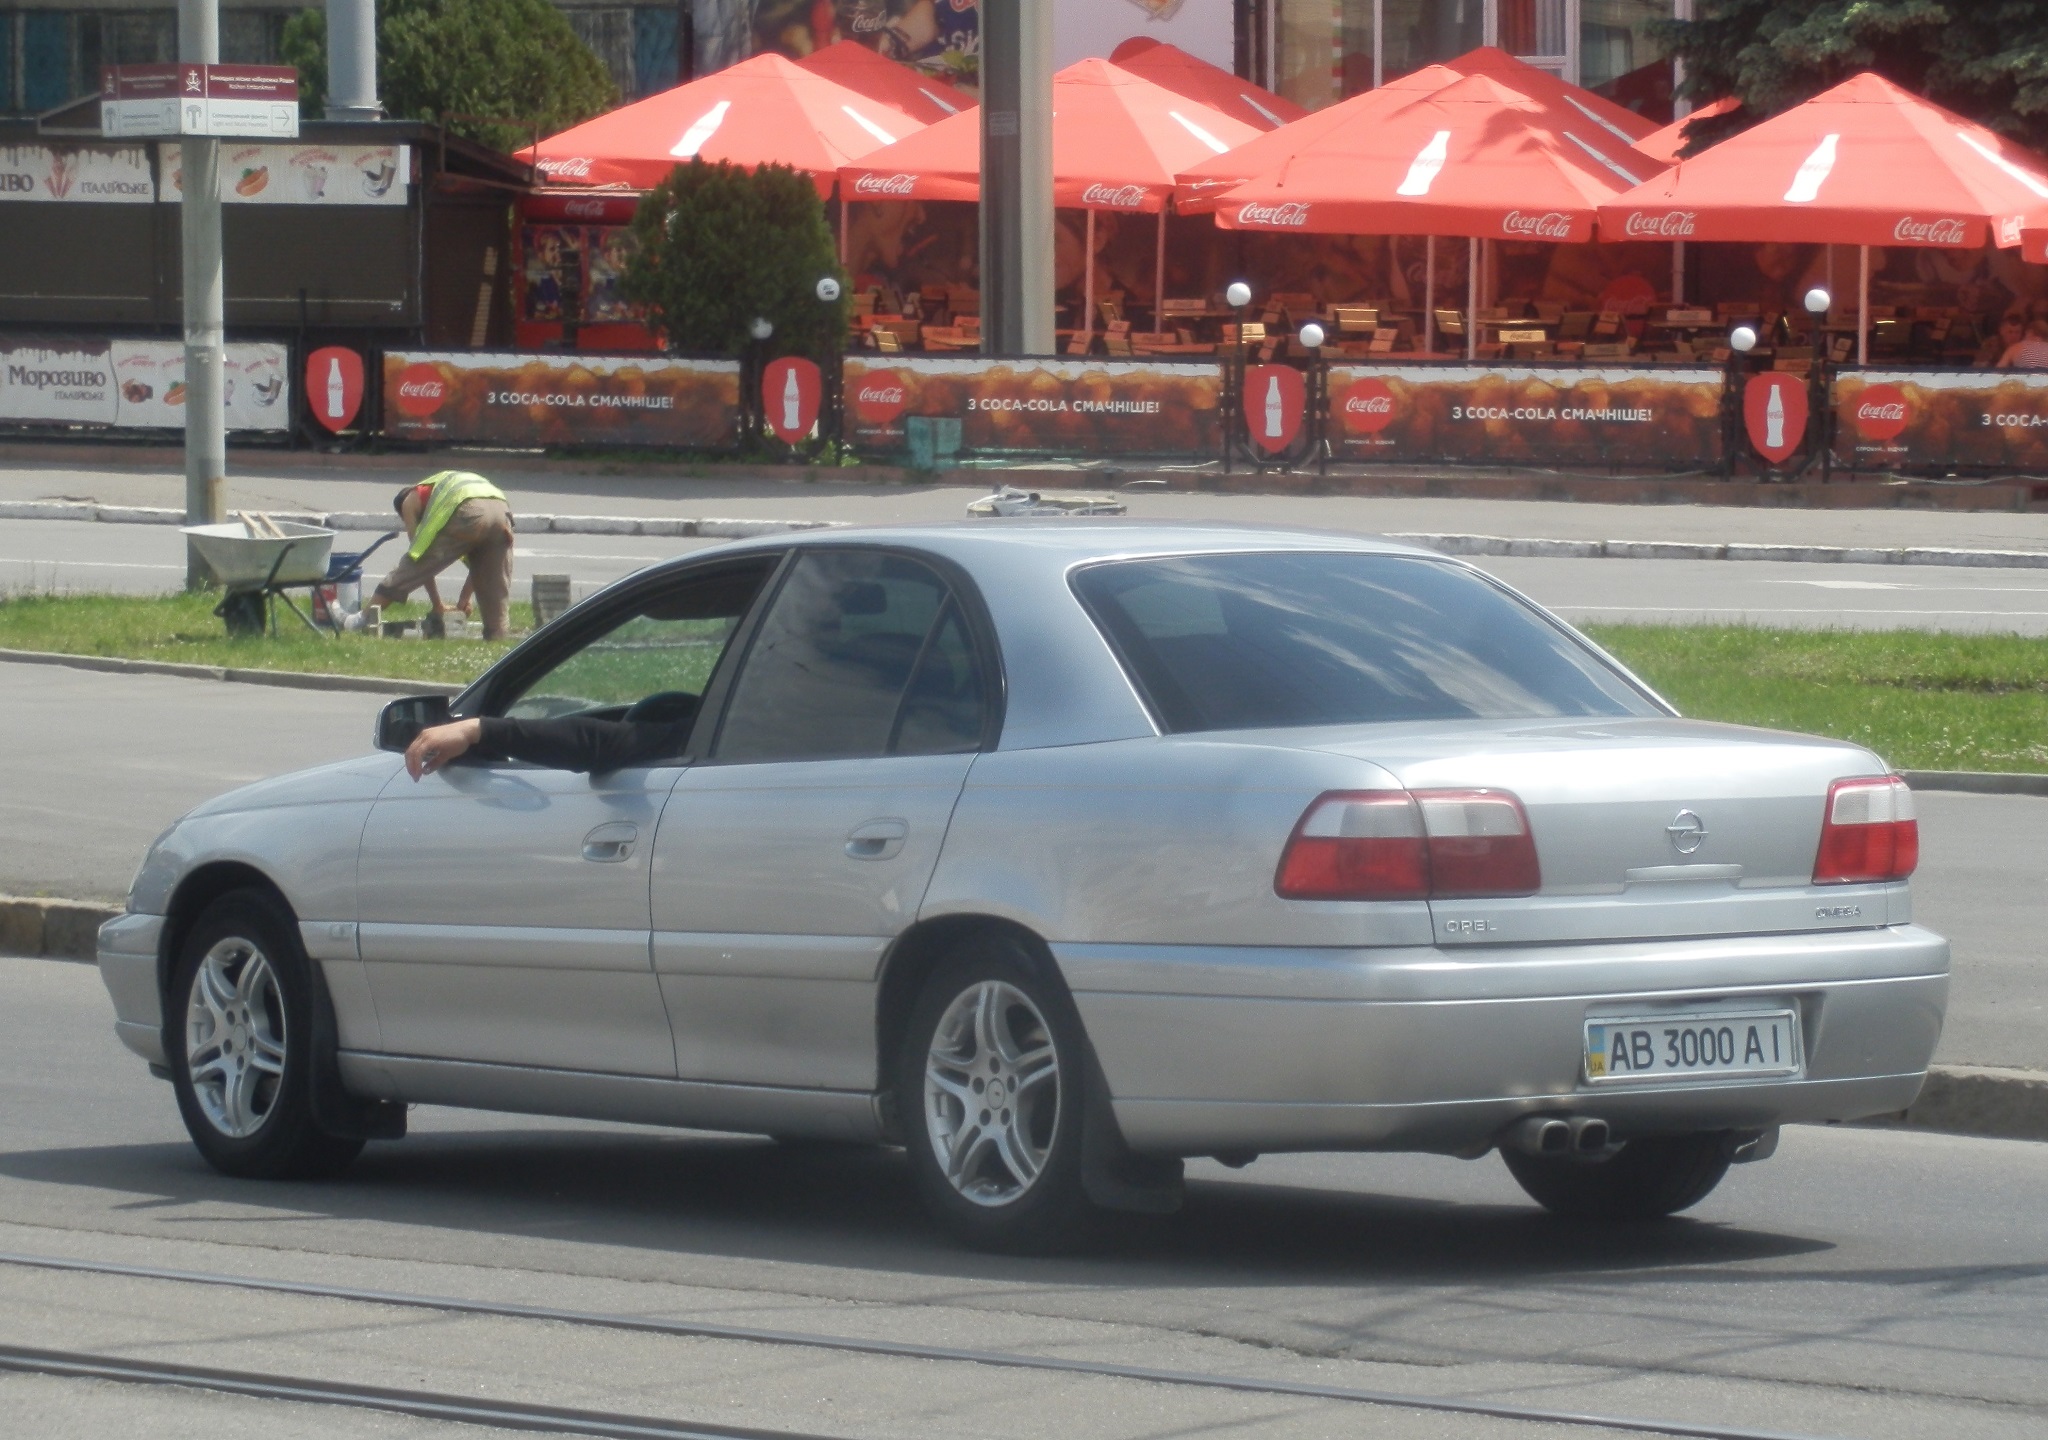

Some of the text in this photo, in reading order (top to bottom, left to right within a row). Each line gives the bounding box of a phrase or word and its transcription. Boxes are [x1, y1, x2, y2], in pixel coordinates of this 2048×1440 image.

[855, 173, 919, 194] Coca-Cola
[1082, 183, 1150, 207] Coca-Cola
[1238, 201, 1311, 227] Coca-Cola
[1625, 211, 1698, 236] Coca-Cola
[1503, 210, 1574, 238] Coca-Cola
[1894, 216, 1967, 244] Coca-Cola
[8, 364, 107, 390] Морозиво
[400, 381, 444, 398] Coca-Cola
[859, 386, 904, 403] Coca-Cola
[499, 392, 586, 407] COCA-COLA
[589, 395, 675, 409] СМАЧНІШЕ!
[979, 398, 1068, 412] COCA-COLA
[1072, 399, 1161, 413] СМАЧНІШЕ!
[1345, 396, 1392, 413] Coca-Cola
[1465, 406, 1557, 421] COCA-COLA
[1561, 407, 1653, 422] СМАЧНІШЕ!
[1857, 402, 1905, 420] Coca-Cola
[1445, 919, 1497, 932] OPEL
[1609, 1030, 1655, 1072] AB
[1663, 1026, 1735, 1068] 3000
